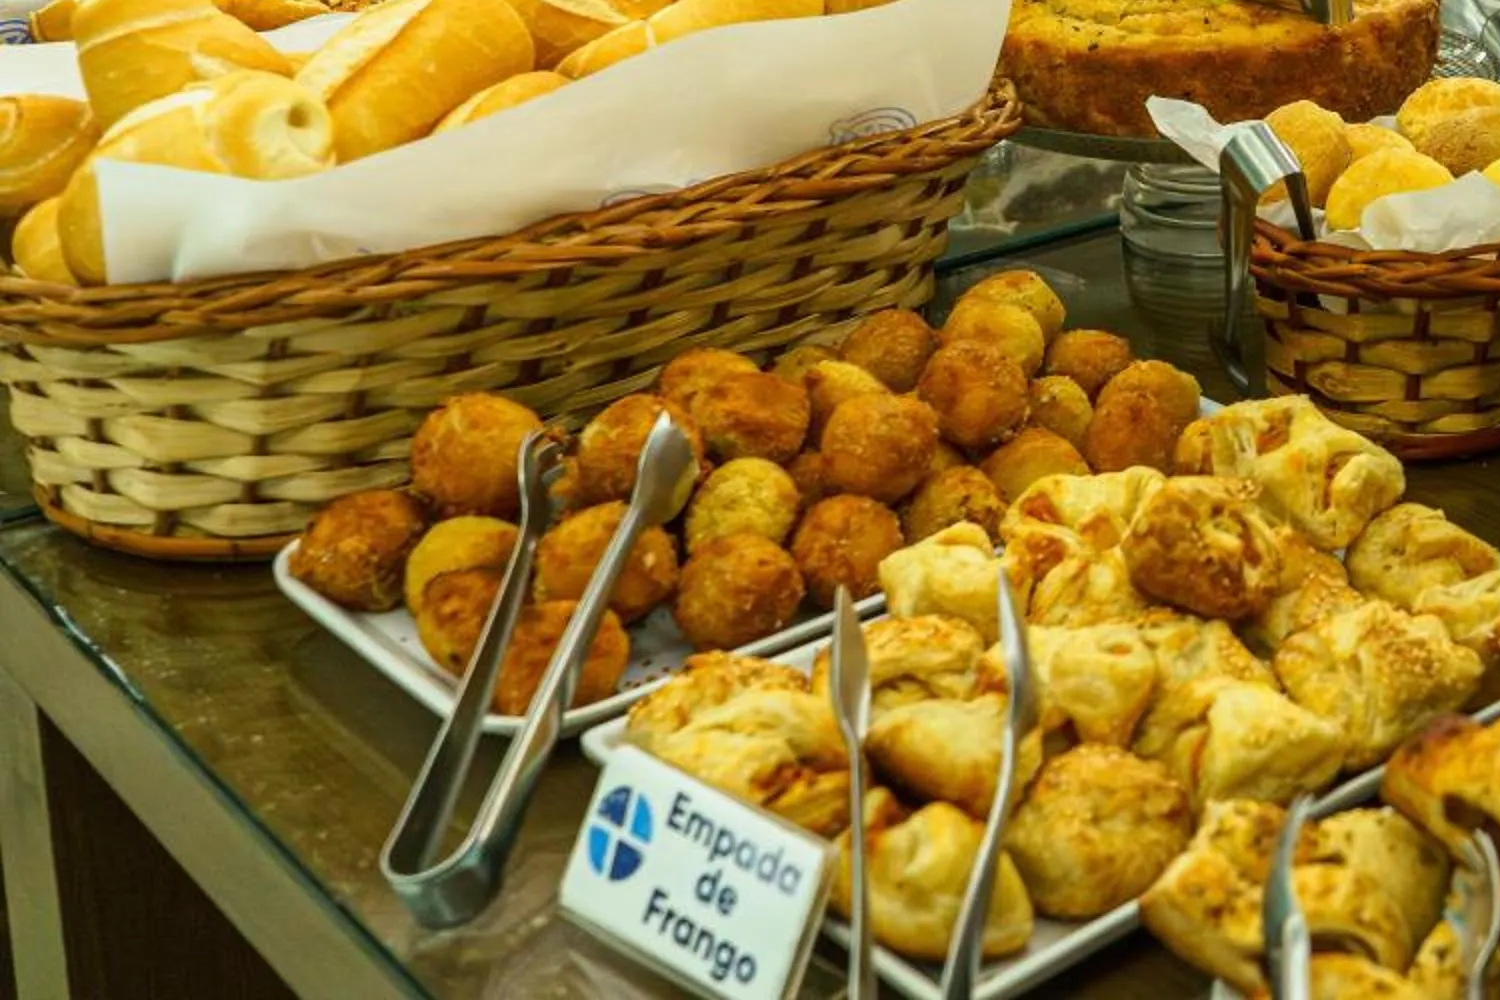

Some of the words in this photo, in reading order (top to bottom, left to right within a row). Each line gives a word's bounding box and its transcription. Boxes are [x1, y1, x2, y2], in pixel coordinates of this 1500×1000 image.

[665, 791, 803, 895] Empada
[641, 888, 758, 986] Frango
[693, 869, 739, 917] de
